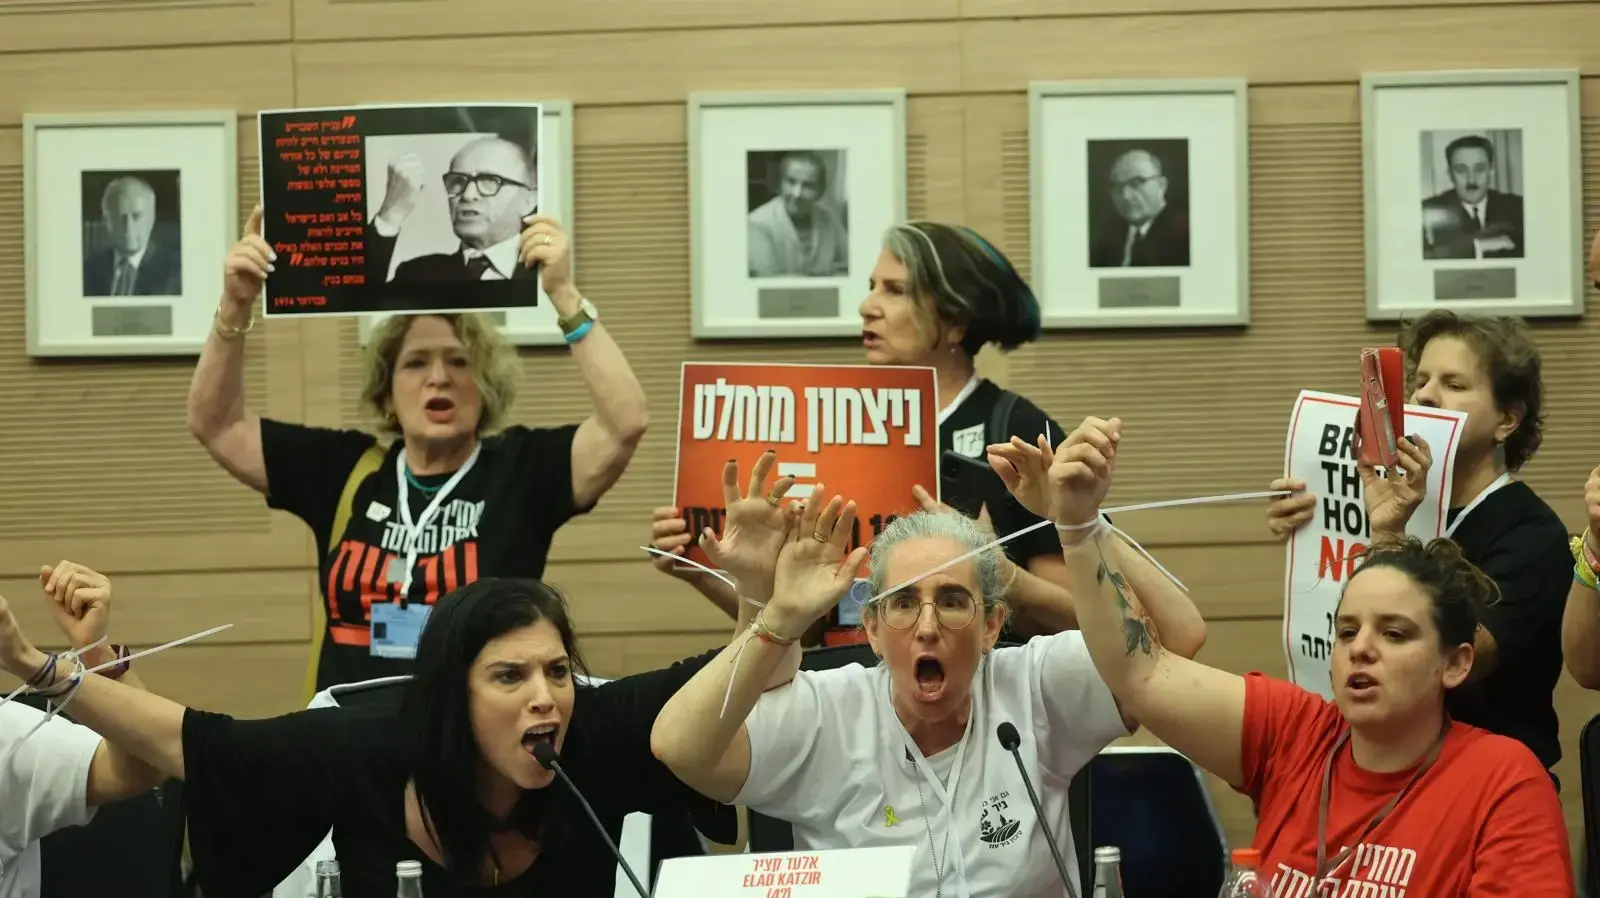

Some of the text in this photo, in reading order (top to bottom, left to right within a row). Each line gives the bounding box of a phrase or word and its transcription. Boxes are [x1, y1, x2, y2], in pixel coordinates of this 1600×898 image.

[693, 378, 921, 453] ניצחון מוחלט
[1323, 497, 1371, 538] HO
[1318, 535, 1369, 582] NO
[743, 871, 821, 888] ELAD KATZIR
[752, 856, 819, 872] אלעד קציר
